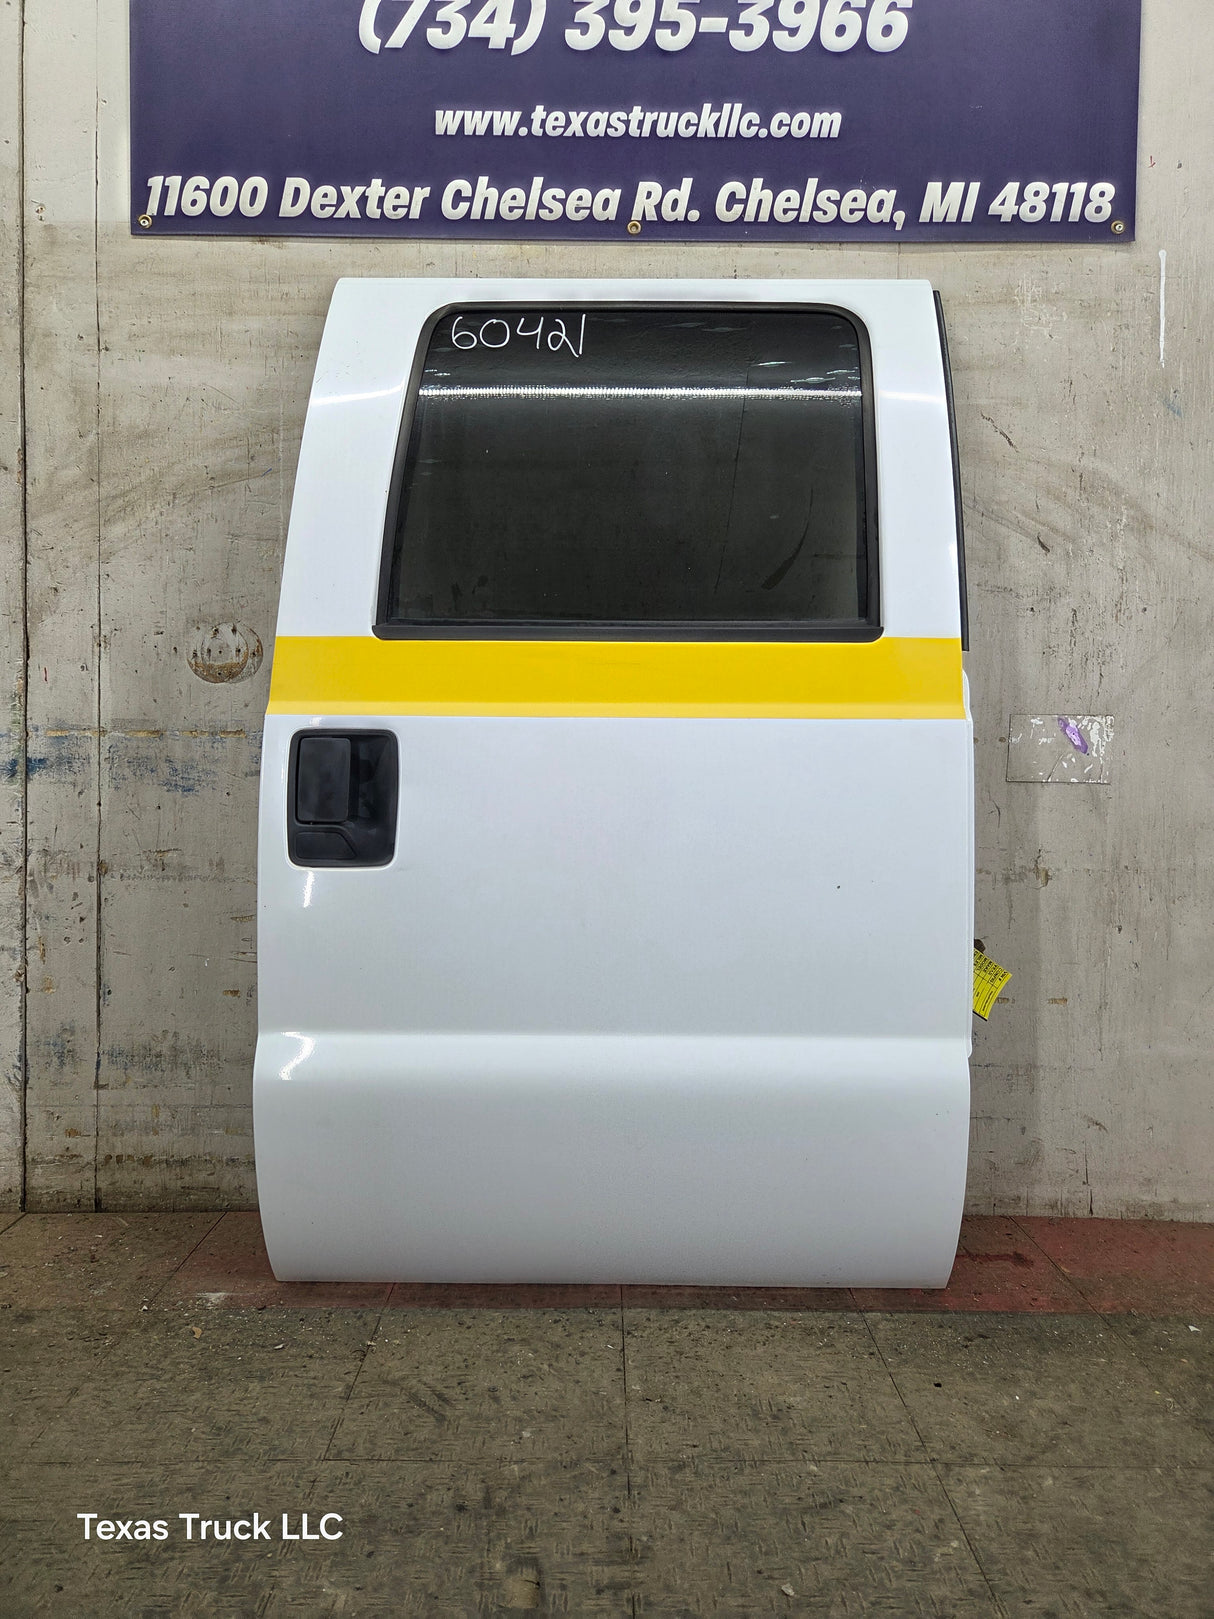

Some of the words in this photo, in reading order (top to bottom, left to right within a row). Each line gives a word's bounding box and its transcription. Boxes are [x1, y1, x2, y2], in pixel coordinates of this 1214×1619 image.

[358, 0, 547, 56] (734)
[564, 0, 914, 53] 395-3966
[435, 103, 843, 138] www.texastruckllc.com
[145, 175, 269, 217] 11600
[278, 177, 431, 220] Dexter
[441, 176, 622, 221] Chelsea
[630, 177, 701, 223] Rd.
[715, 177, 906, 230] Chelsea,
[918, 181, 981, 223] MI
[987, 181, 1116, 223] 48118
[451, 313, 587, 358] 60421
